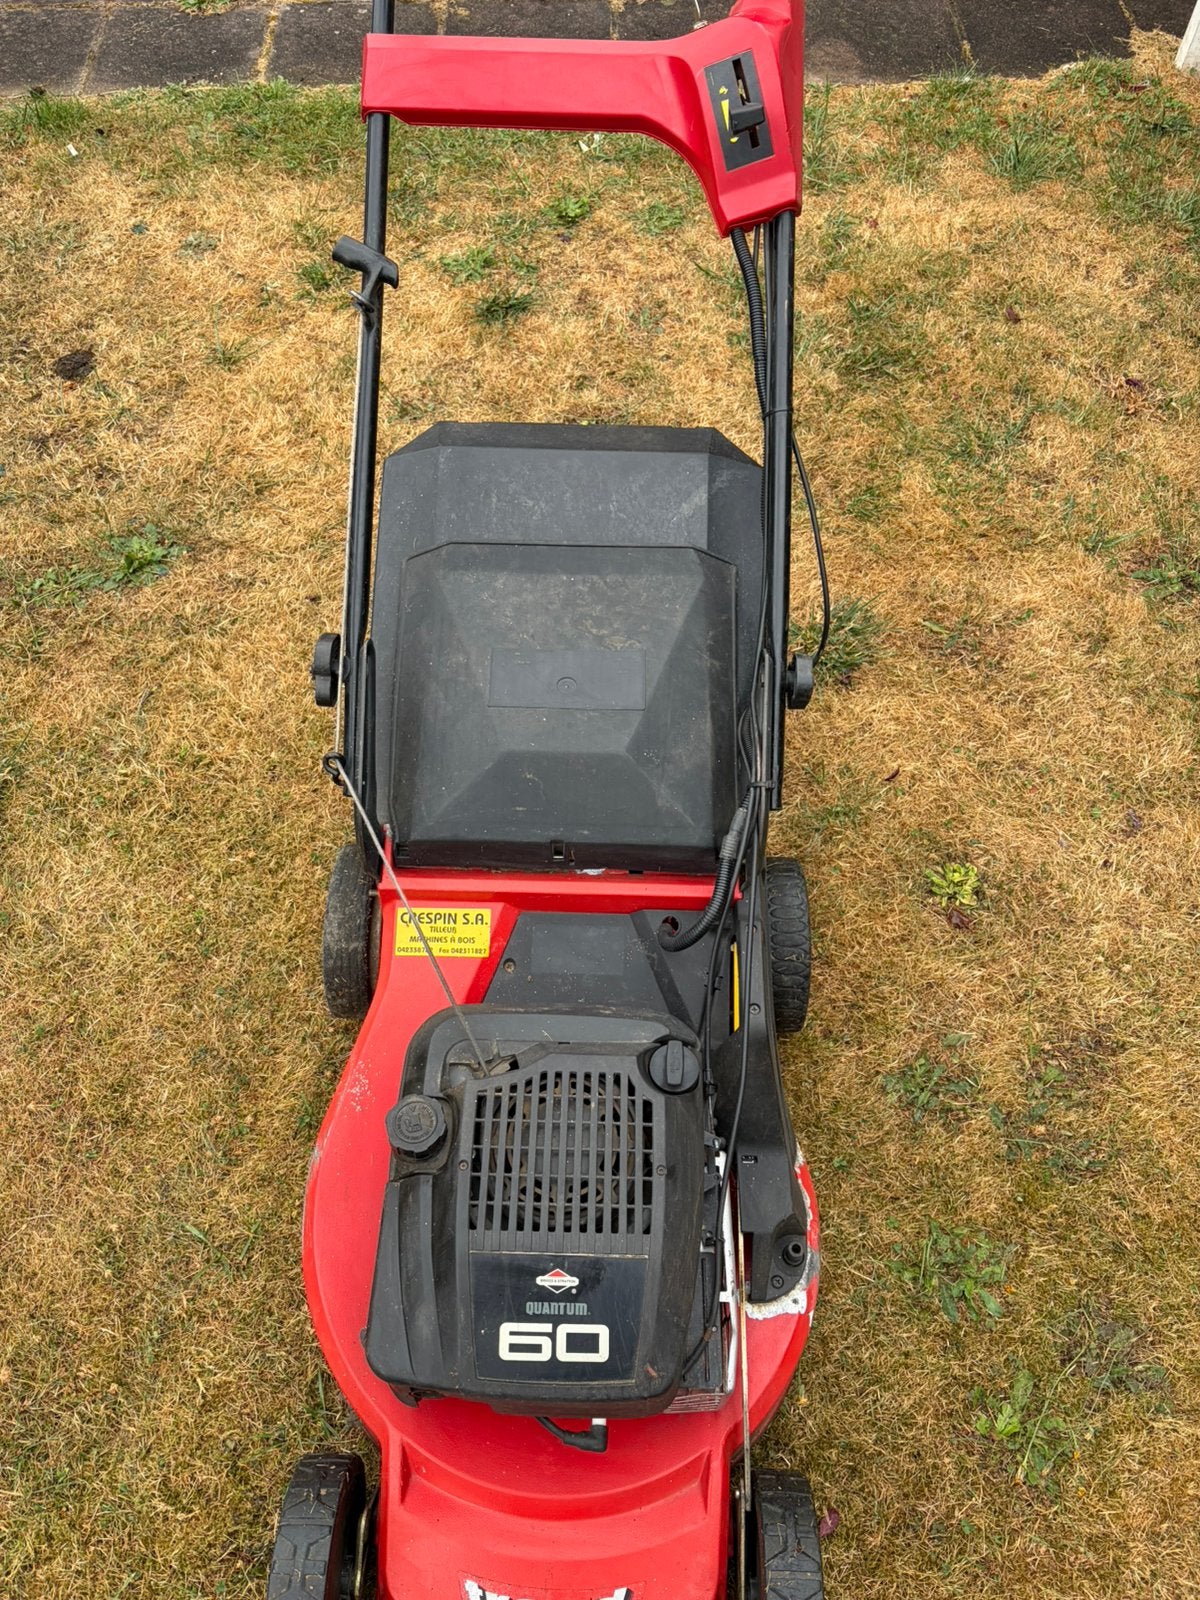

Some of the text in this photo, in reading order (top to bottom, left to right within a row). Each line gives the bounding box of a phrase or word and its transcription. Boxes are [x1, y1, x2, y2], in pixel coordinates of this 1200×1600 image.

[400, 912, 488, 925] CRESPIN S.A.
[409, 935, 448, 943] MAHINES
[457, 936, 476, 944] BOIS
[525, 1301, 588, 1316] QUANTUM
[498, 1321, 610, 1363] 60
